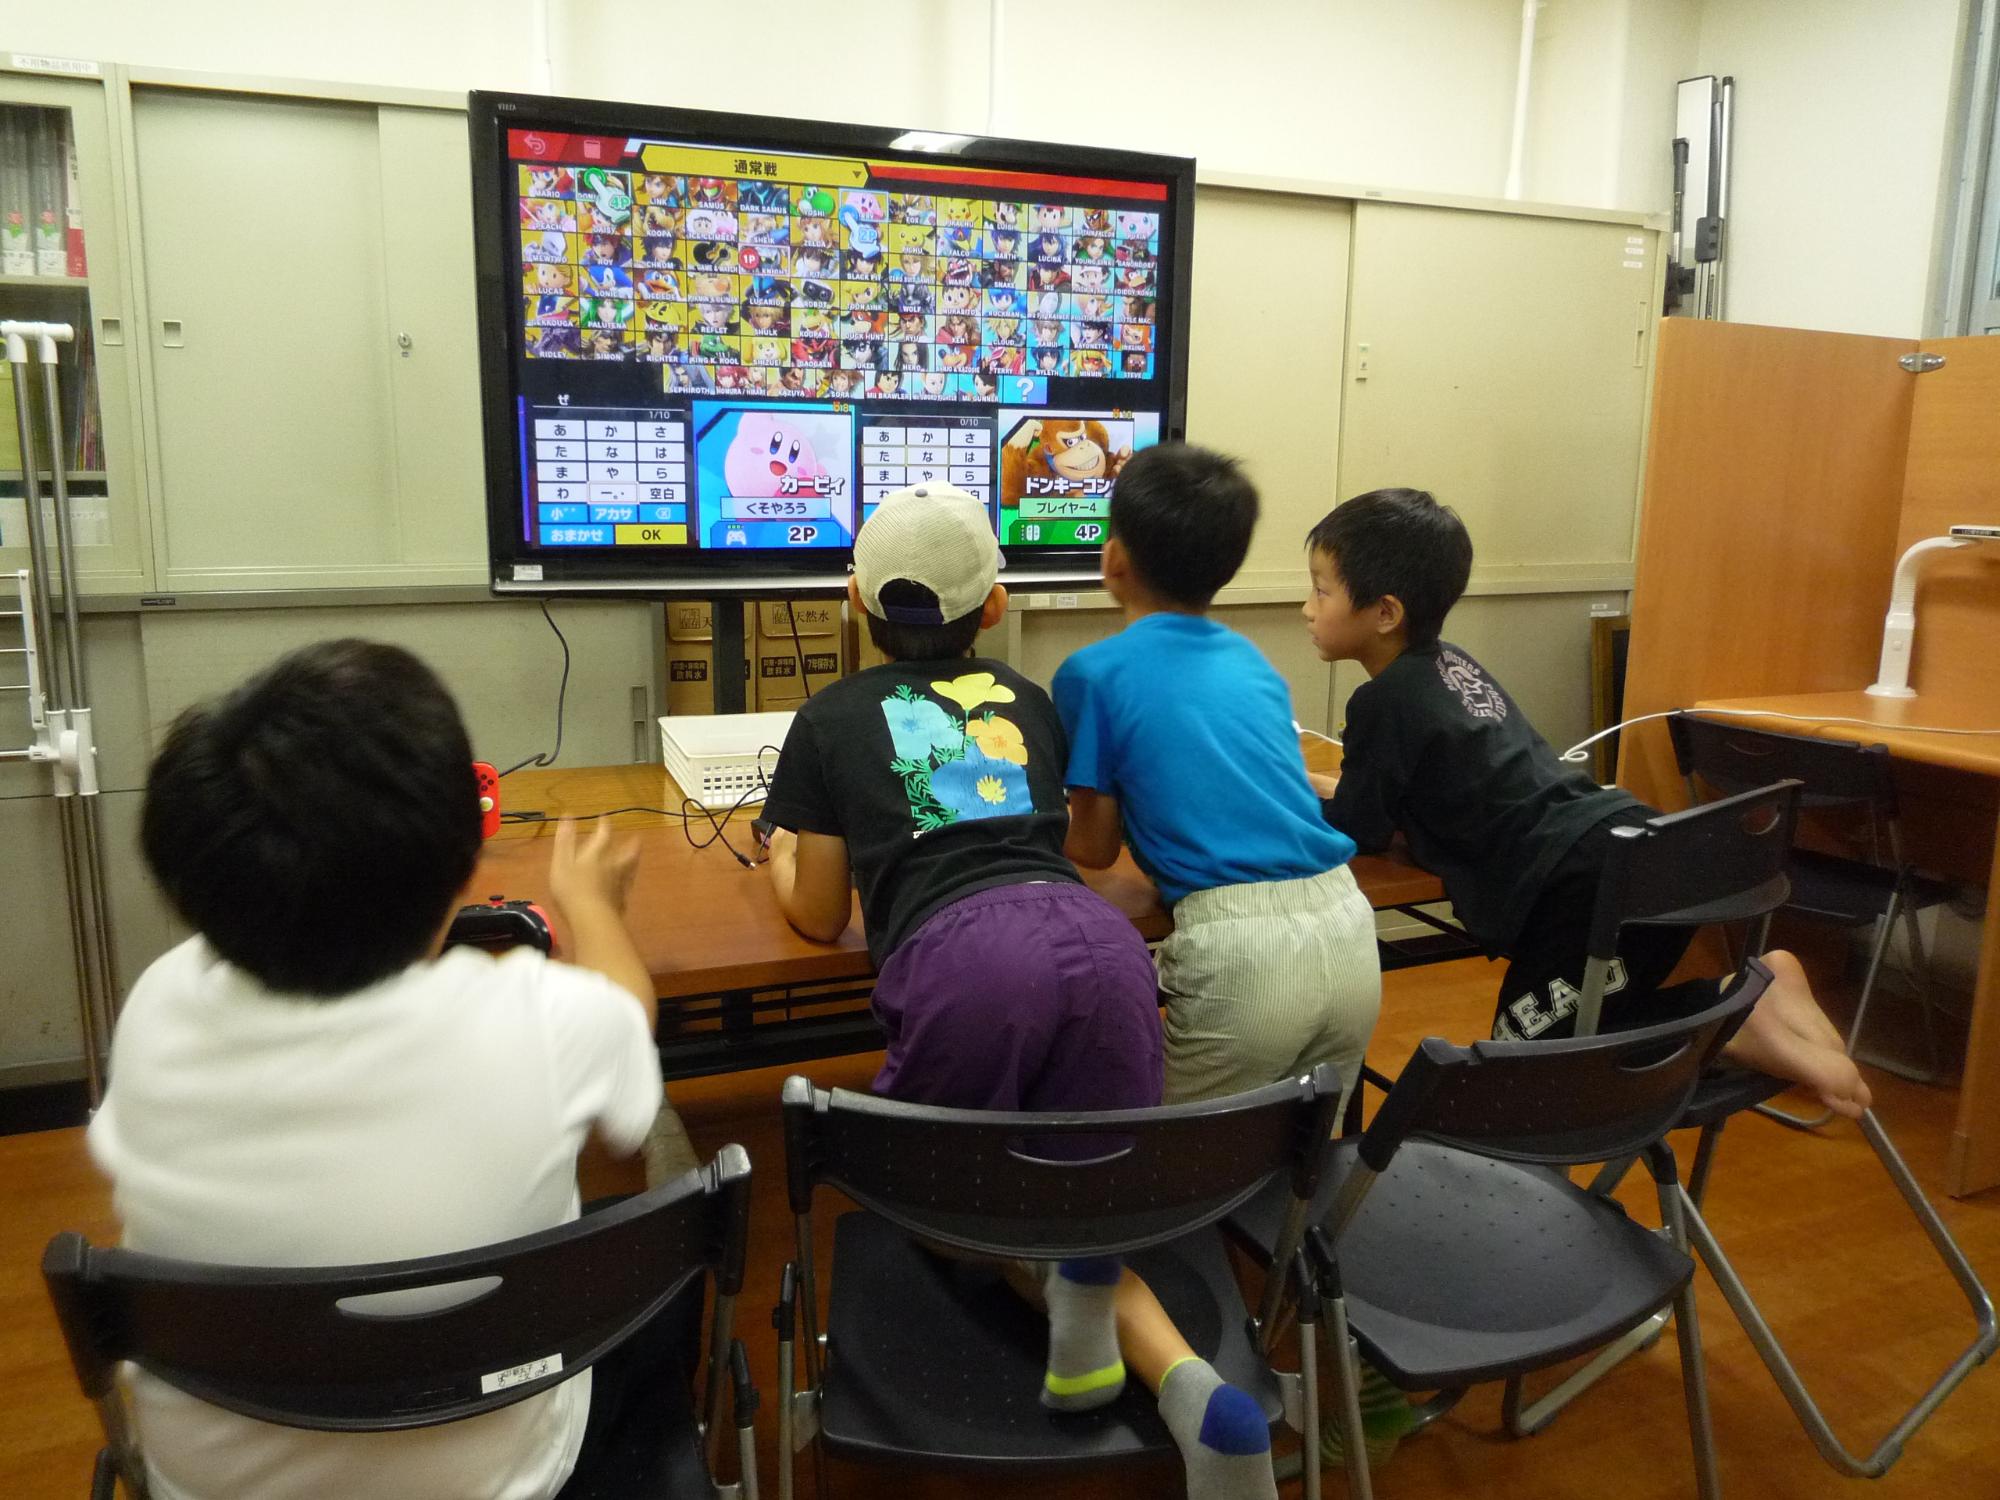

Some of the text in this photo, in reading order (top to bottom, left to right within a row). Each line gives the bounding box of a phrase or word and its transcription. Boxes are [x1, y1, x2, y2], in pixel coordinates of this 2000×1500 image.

[734, 159, 778, 177] 通常戦
[534, 190, 561, 198] MARIO
[699, 201, 725, 209] SAMUS
[740, 203, 787, 213] DARK SAMUS
[804, 209, 825, 217] YOSHI
[906, 215, 919, 224] FOX
[536, 222, 562, 230] PEACH
[647, 230, 671, 238] KOOPA
[531, 254, 567, 263] MEWTWO
[743, 254, 756, 264] 1P
[847, 272, 869, 280] BLACK
[538, 287, 564, 295] LUCAS
[595, 289, 617, 297] SONIC
[750, 297, 781, 305] LUCARIO
[803, 300, 827, 308] ROBOT
[903, 304, 921, 312] WOLF
[588, 321, 626, 329] PALUTENA
[645, 323, 678, 331] PAC-MAN
[800, 330, 822, 338] KOOPA
[1038, 340, 1058, 348] KAMUI
[1073, 342, 1109, 350] BAYONETTA
[540, 351, 567, 359] RIDLEY
[596, 353, 620, 361] SIMON
[646, 355, 678, 363] RICHTER
[690, 356, 709, 364] KING
[720, 357, 739, 365] ROOL
[670, 386, 710, 394] SEPHIROTH
[779, 389, 805, 397] KAZUYA
[1016, 377, 1034, 402] ?
[880, 392, 910, 400] BRAWLER
[649, 410, 670, 419] 1/10
[960, 418, 978, 426] 0/10
[554, 424, 666, 438] あ か さ
[879, 431, 975, 443] あ か さ
[555, 446, 667, 459] た な は
[879, 451, 975, 462] た な は
[556, 466, 667, 479] ま や ら
[880, 470, 974, 481] ま や ら
[780, 475, 845, 496] カービィ
[1026, 477, 1114, 495] ドンキーコン
[557, 487, 569, 499] わ
[650, 487, 675, 500] 空白
[746, 502, 807, 514] くそやろう
[1037, 502, 1096, 514] プレイヤー4
[595, 507, 632, 520] アカサ
[551, 530, 604, 542] おまかせ
[641, 529, 661, 541] OK
[788, 525, 817, 543] 2P
[1075, 523, 1103, 541] 4P
[796, 609, 830, 624] 天然水
[1491, 956, 1629, 1043] EAD
